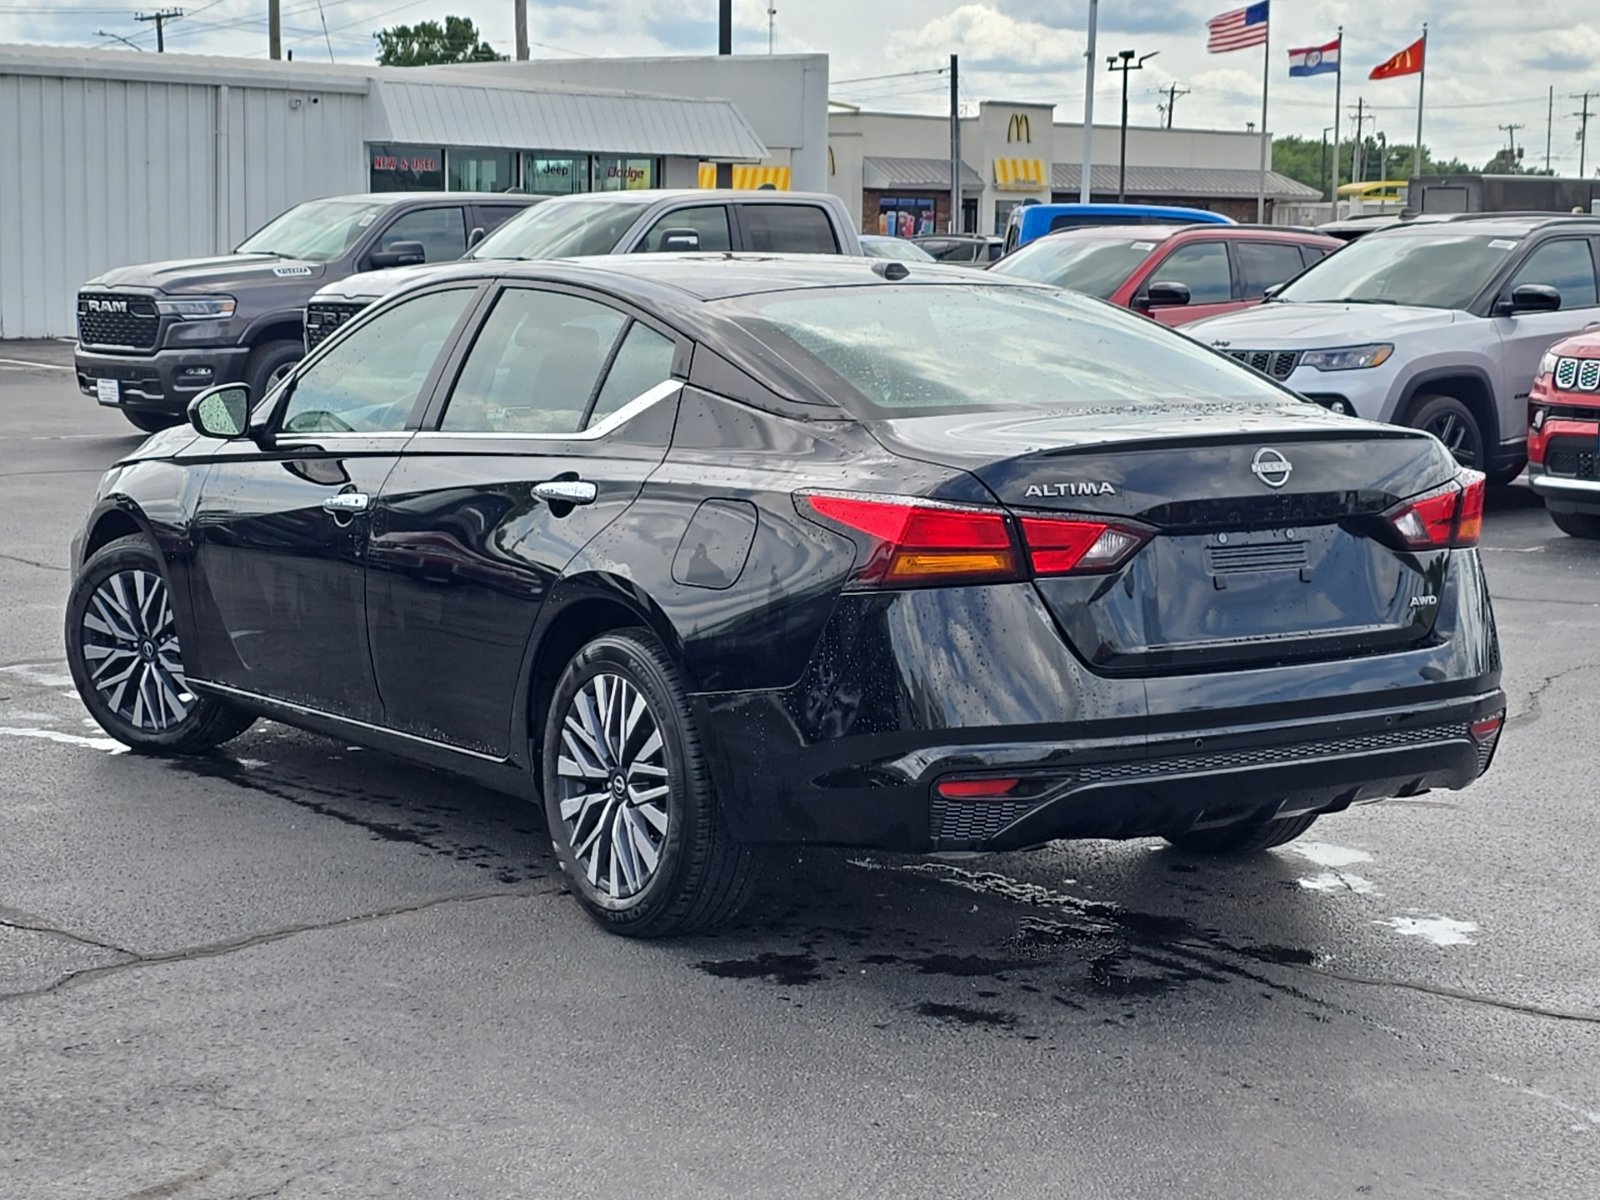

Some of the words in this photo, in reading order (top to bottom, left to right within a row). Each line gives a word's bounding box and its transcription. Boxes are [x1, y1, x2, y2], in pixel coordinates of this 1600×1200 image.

[374, 155, 397, 171] NEW
[411, 156, 438, 172] USED
[542, 163, 569, 177] Jeep
[607, 165, 645, 182] Dodge
[88, 299, 127, 313] RAM
[1024, 481, 1116, 498] ALTIMA
[1409, 595, 1438, 608] AWD
